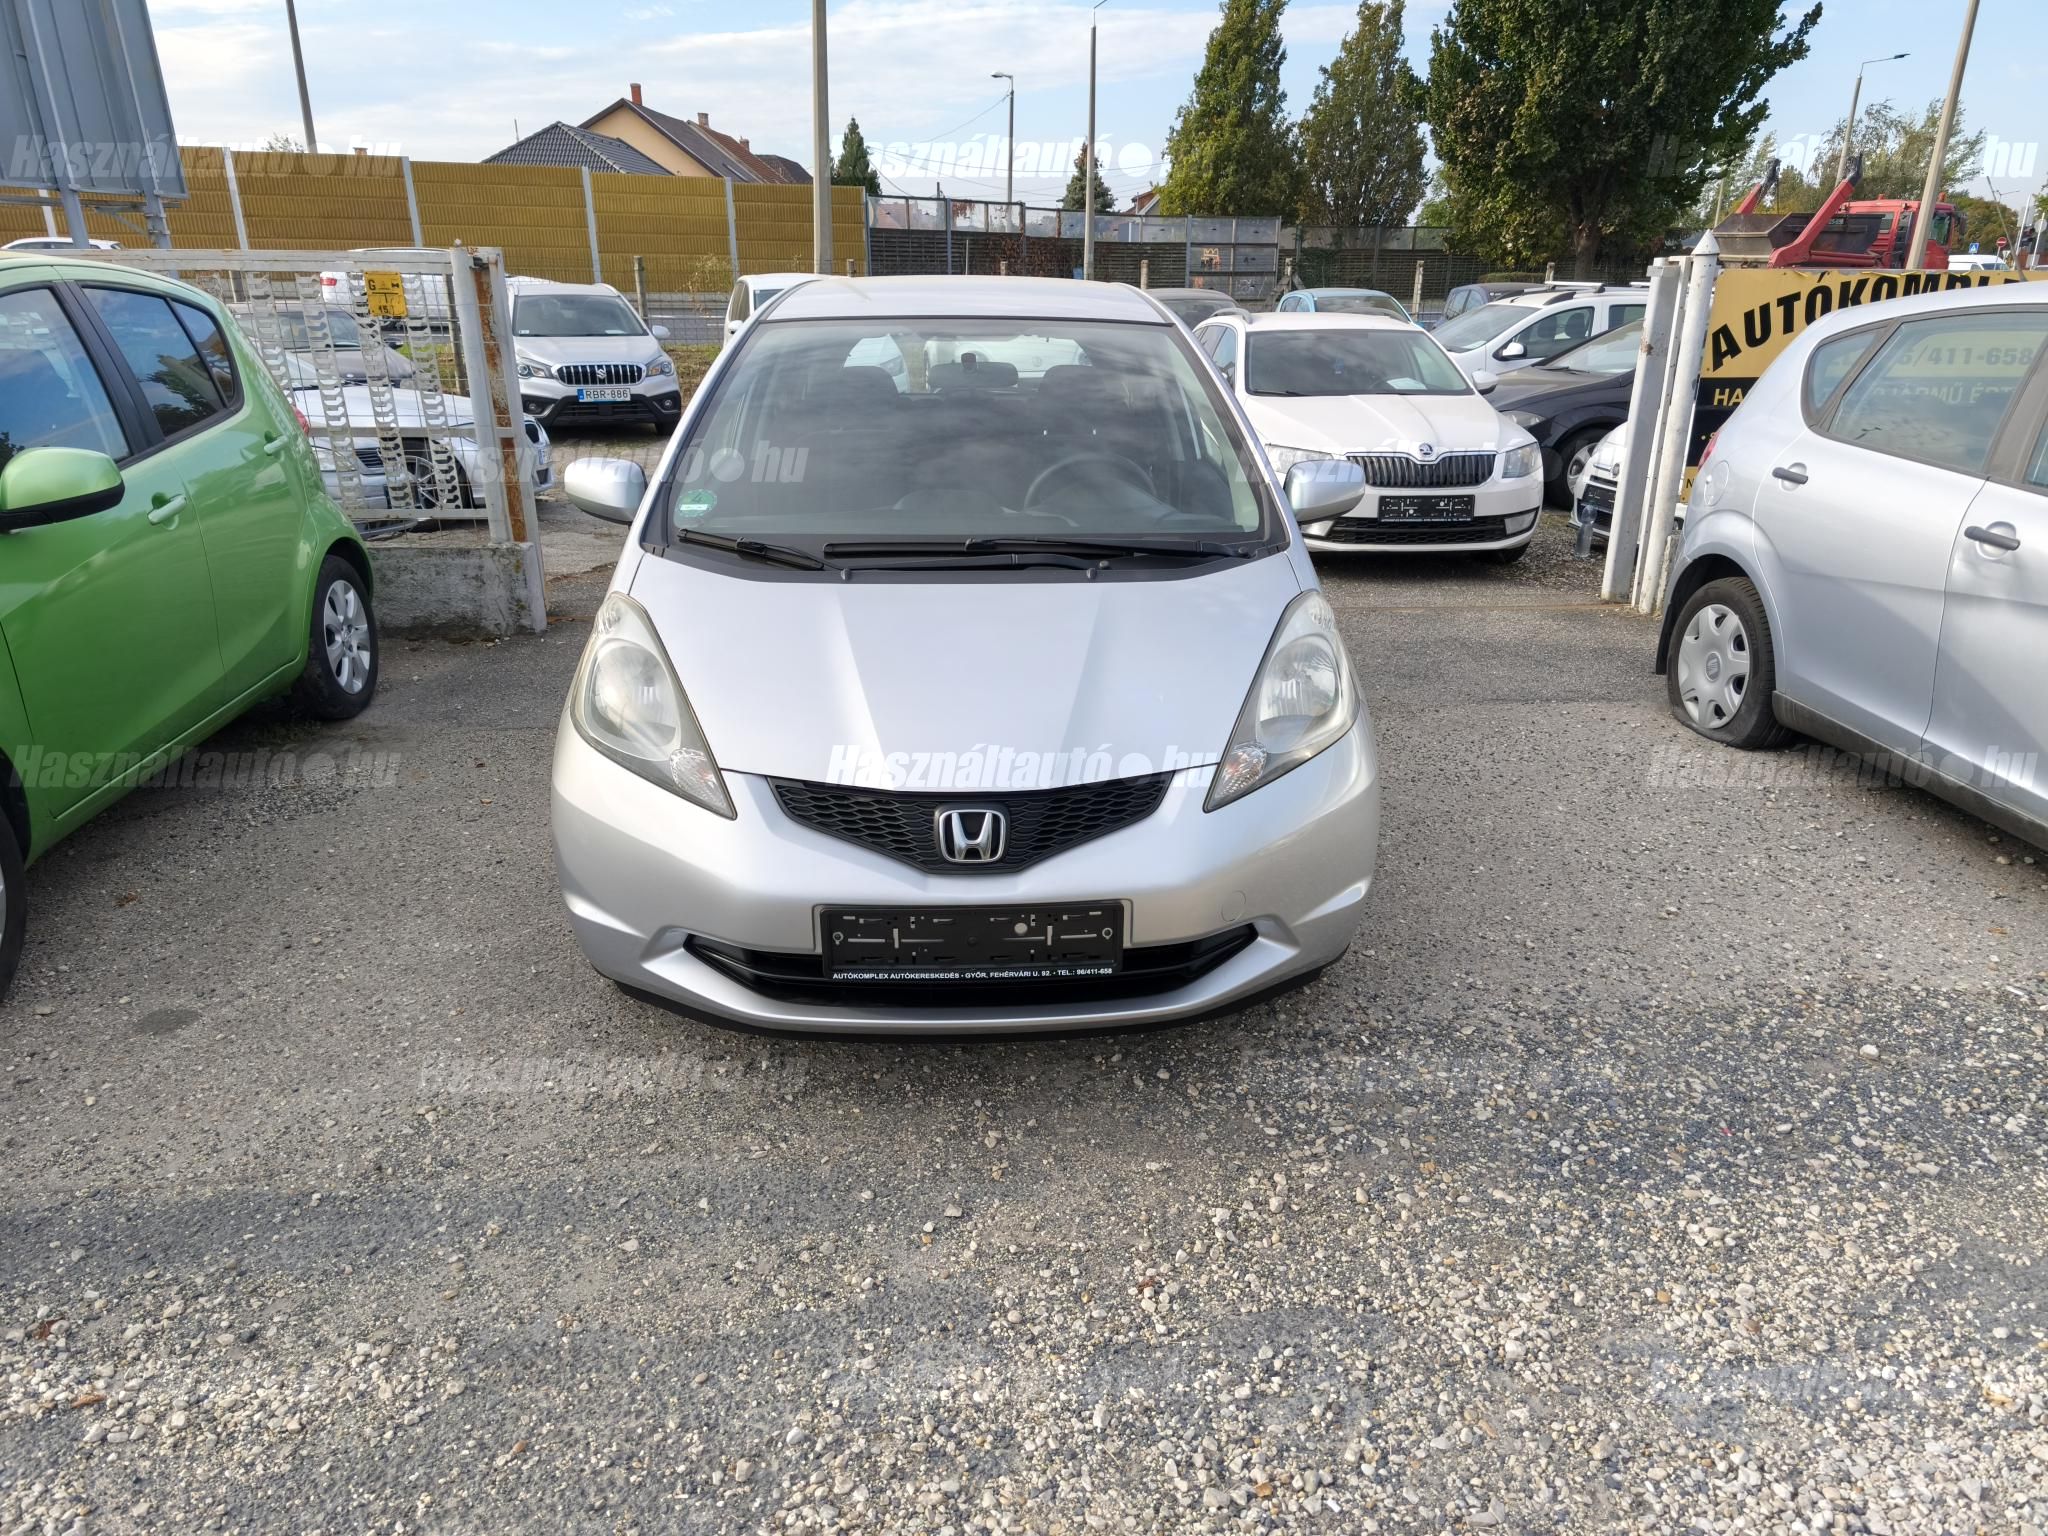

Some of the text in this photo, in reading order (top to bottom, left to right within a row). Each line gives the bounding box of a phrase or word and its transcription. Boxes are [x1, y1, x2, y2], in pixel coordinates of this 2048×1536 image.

[368, 280, 376, 290] G
[585, 390, 628, 400] RBR-886
[990, 970, 1031, 978] FEHÉRVÁRI
